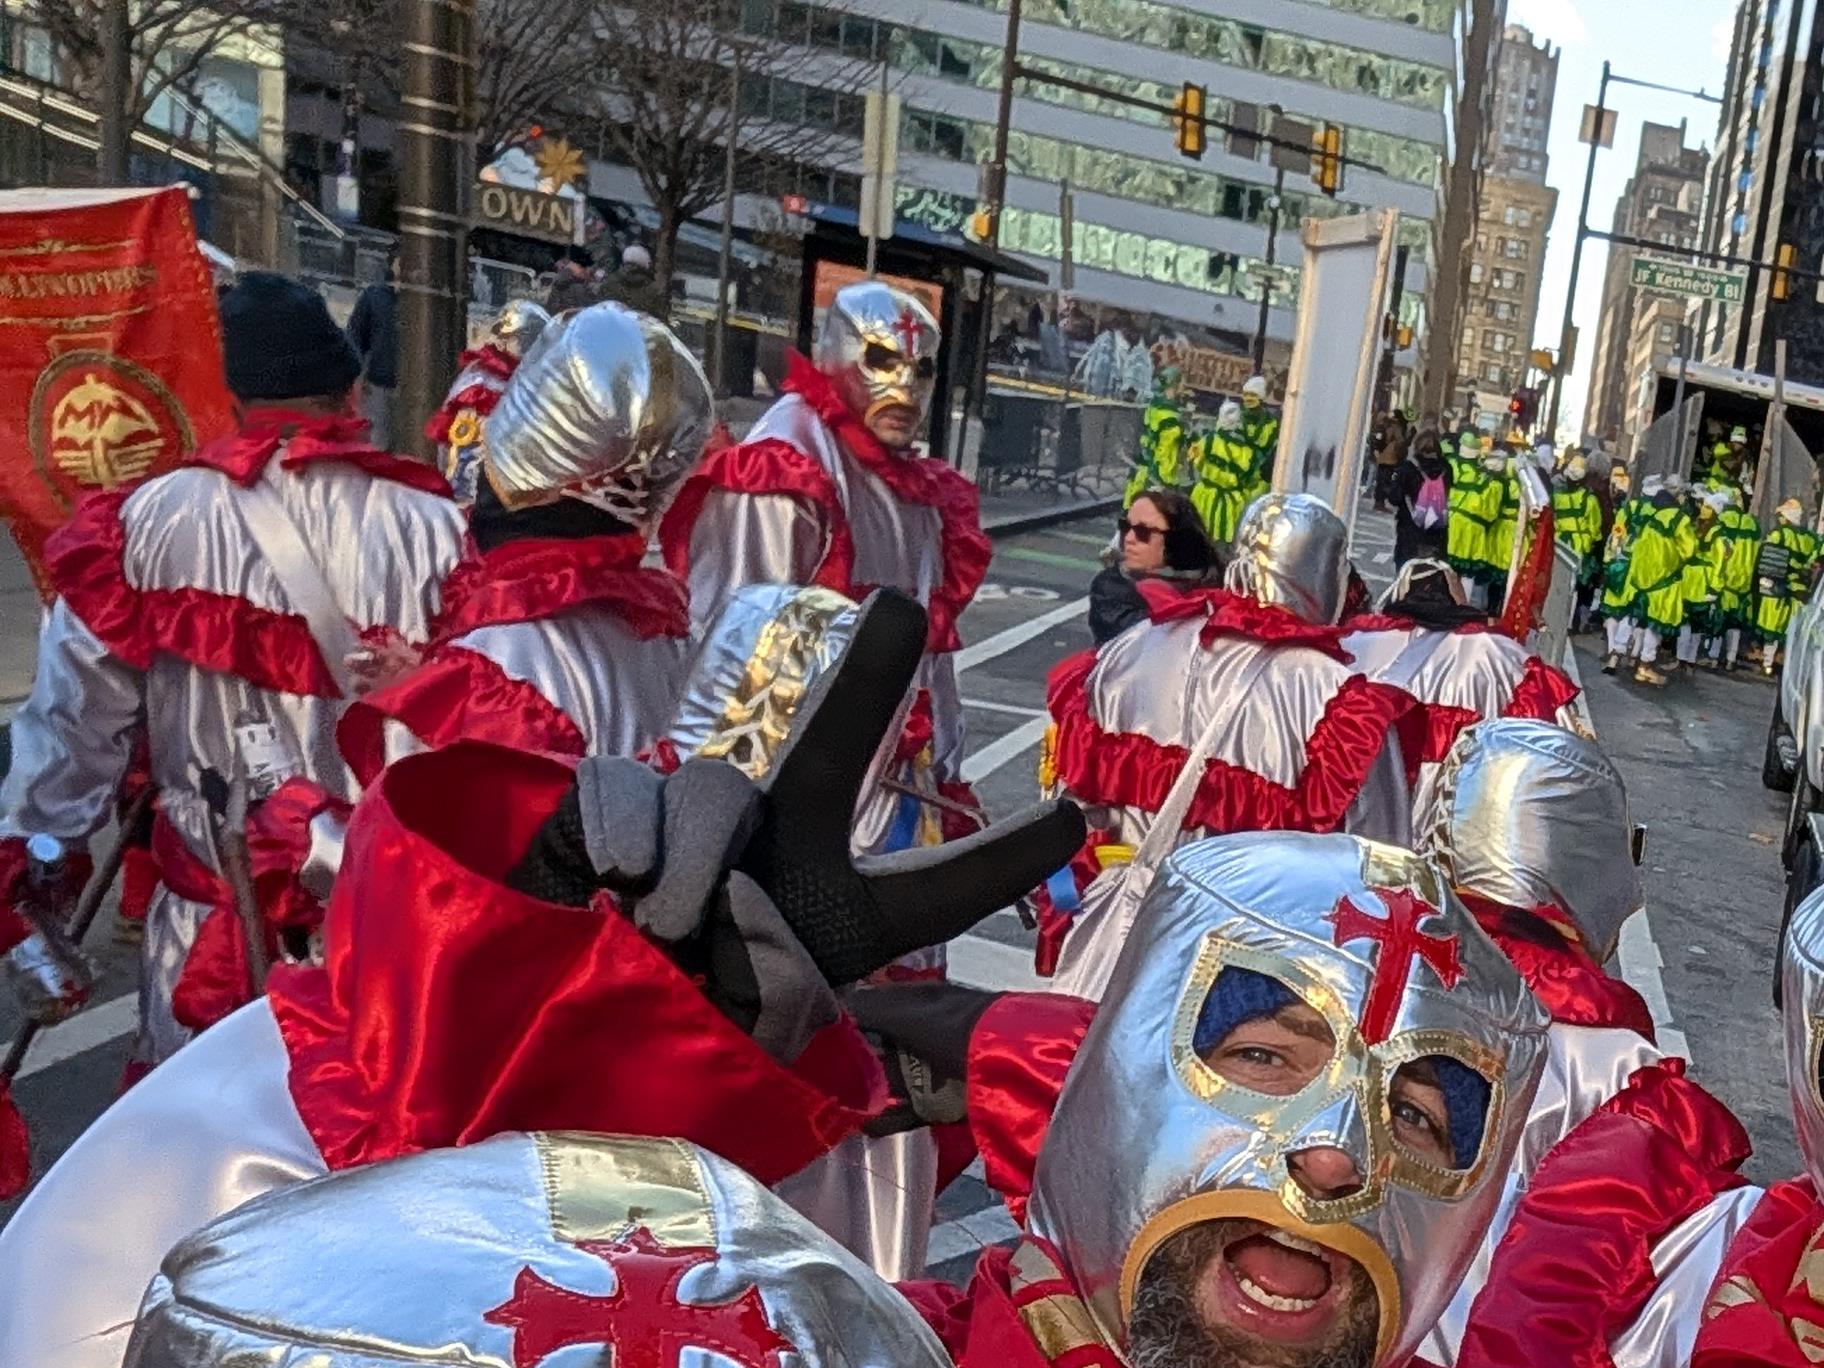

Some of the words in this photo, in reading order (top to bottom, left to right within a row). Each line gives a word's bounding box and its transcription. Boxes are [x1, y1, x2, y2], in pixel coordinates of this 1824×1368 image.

[473, 182, 573, 233] OWN
[1634, 269, 1651, 282] JF
[1655, 272, 1720, 296] Kennedy
[1724, 283, 1740, 299] Bl
